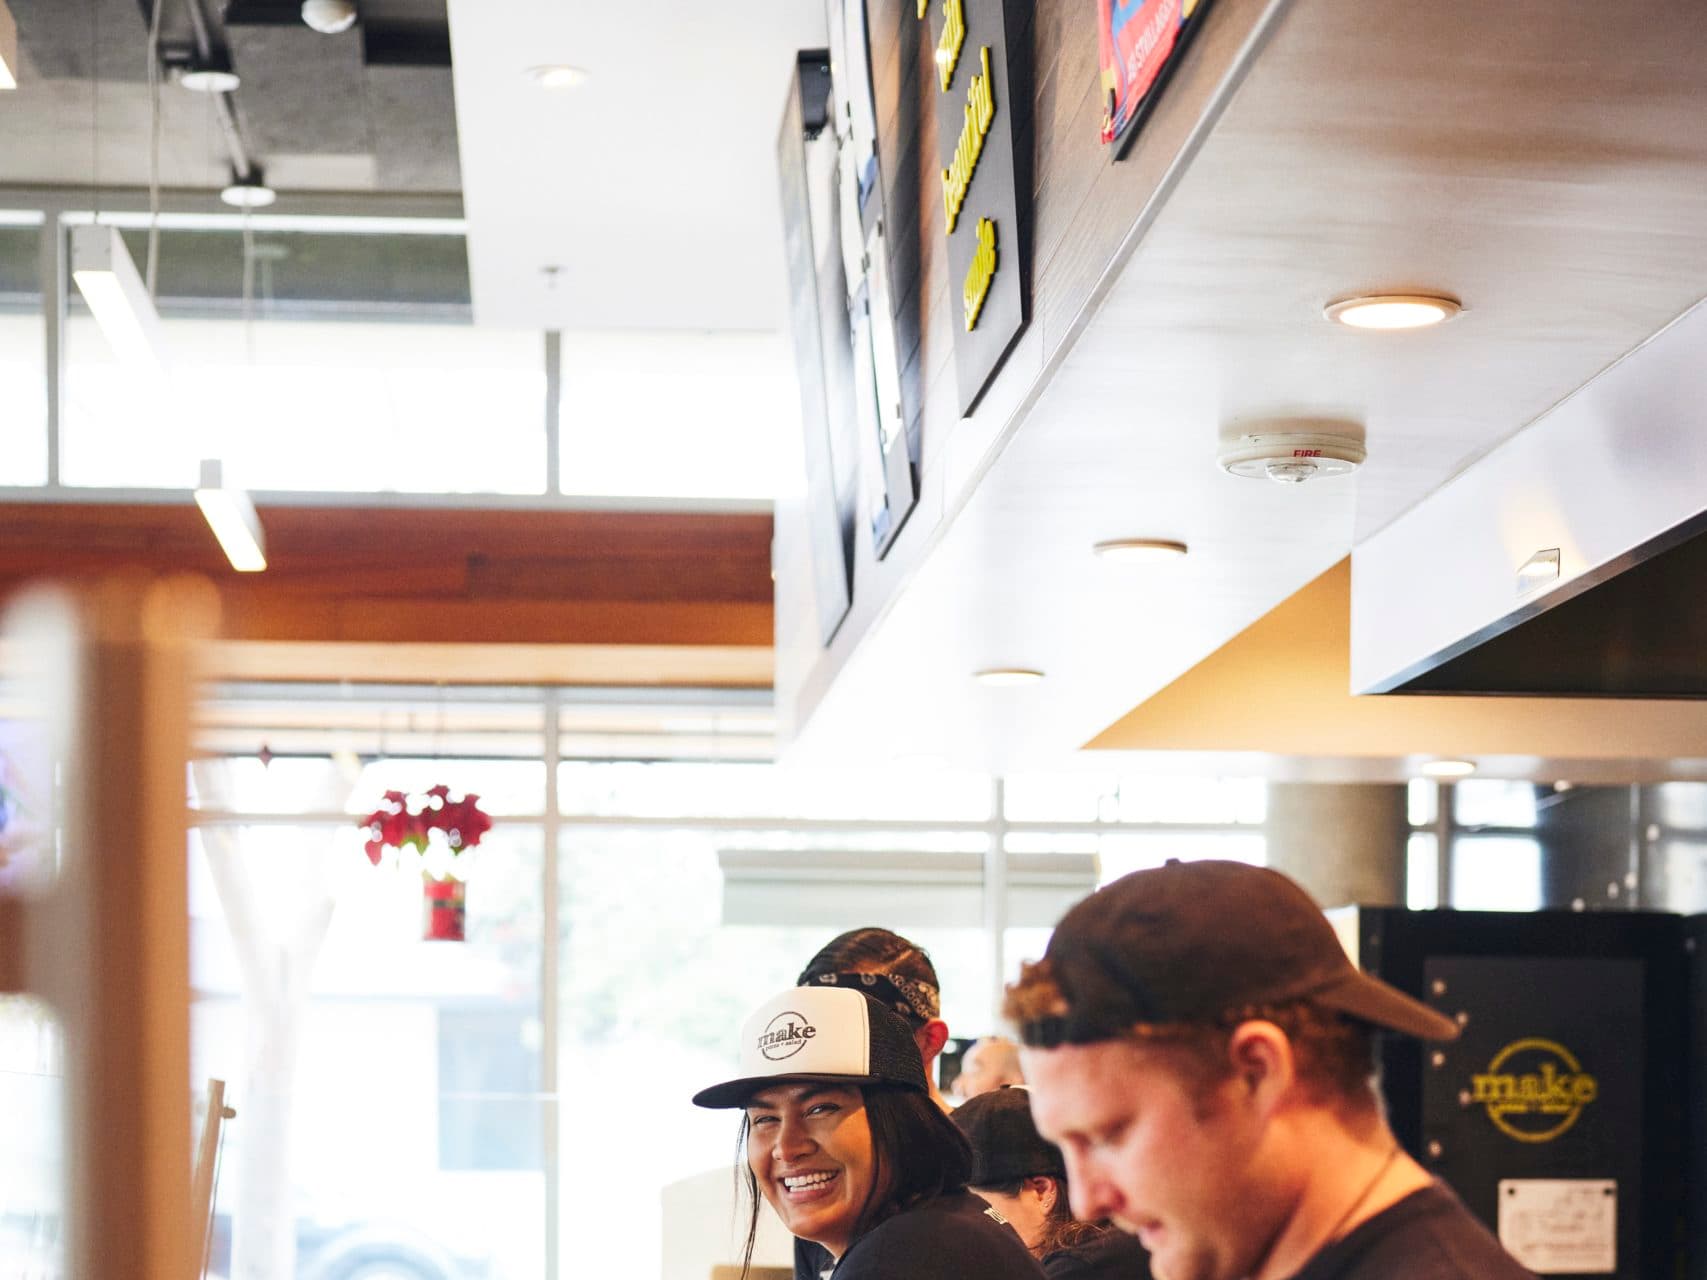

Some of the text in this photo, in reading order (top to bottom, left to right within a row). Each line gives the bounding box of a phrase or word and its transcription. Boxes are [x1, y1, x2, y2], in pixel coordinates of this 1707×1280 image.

[1293, 449, 1322, 458] FIRE
[757, 1022, 816, 1048] make
[1473, 1063, 1597, 1104] make
